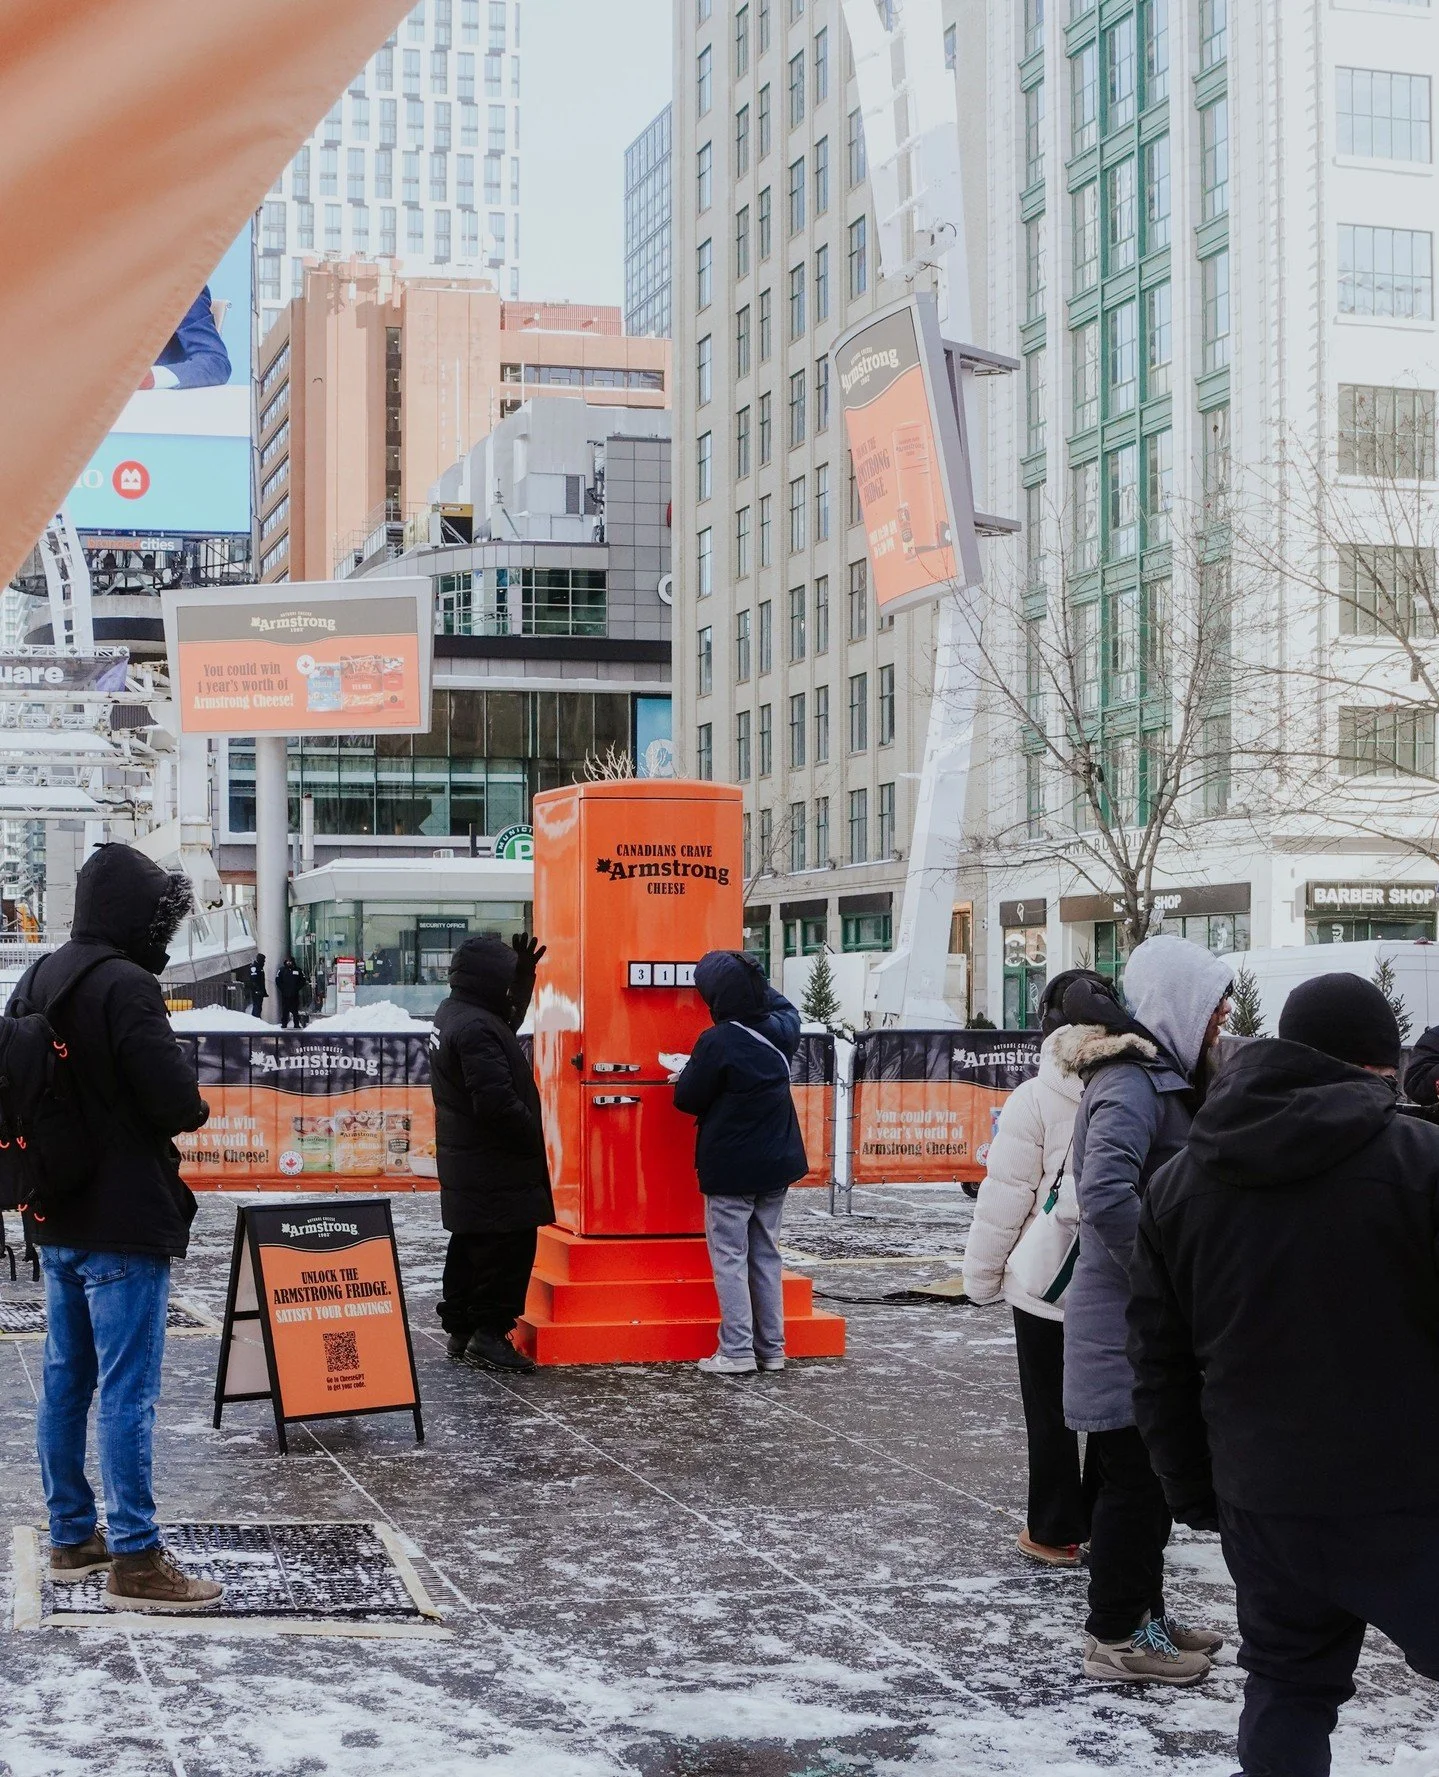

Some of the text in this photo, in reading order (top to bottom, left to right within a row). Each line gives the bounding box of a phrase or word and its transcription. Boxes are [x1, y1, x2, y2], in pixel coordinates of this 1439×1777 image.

[259, 615, 336, 632] Armstrong
[203, 662, 281, 677] You could win
[206, 680, 239, 694] year's
[242, 678, 274, 692] worth
[277, 677, 289, 690] of
[193, 693, 295, 710] Armstrong Cheese!
[616, 844, 713, 857] CANADIANS CRAVE
[609, 859, 730, 886] Armstrong
[647, 882, 686, 895] CHEESE
[1314, 888, 1436, 905] BARBER SHOP
[1154, 894, 1182, 910] SHOP
[262, 1052, 379, 1076] Armstrong
[233, 1115, 256, 1130] win
[875, 1109, 957, 1123] You could win
[211, 1132, 248, 1147] worth
[252, 1132, 264, 1147] of
[877, 1126, 911, 1140] year's
[914, 1125, 948, 1139] worth
[951, 1125, 964, 1139] of
[223, 1149, 269, 1163] Cheese!
[862, 1141, 922, 1156] Armstrong
[926, 1141, 968, 1156] Cheese!
[290, 1221, 358, 1238] Armstrong
[301, 1268, 359, 1285] UNLOCK THE
[273, 1280, 392, 1305] ARMSTRONG FRIDGE.
[275, 1300, 393, 1324] SATISFY YOUR CRAVINGS!
